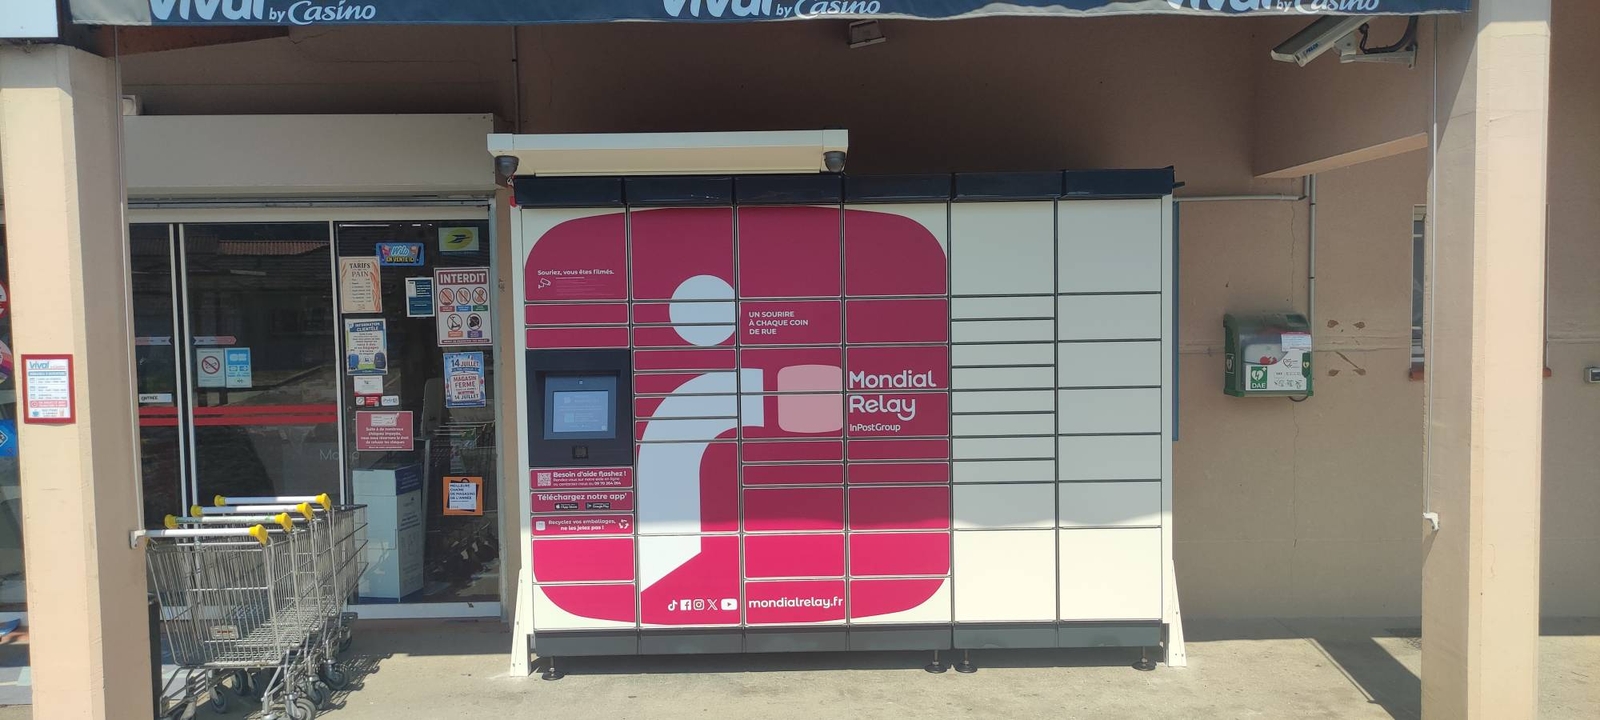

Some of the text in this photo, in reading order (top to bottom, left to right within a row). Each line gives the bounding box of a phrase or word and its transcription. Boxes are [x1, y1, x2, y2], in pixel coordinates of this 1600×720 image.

[269, 8, 286, 22] by
[288, 0, 376, 25] Casino
[776, 4, 792, 18] by
[794, 0, 880, 19] Casino
[1276, 0, 1290, 12] by
[440, 273, 485, 284] INTERDIT
[452, 359, 460, 367] 14
[850, 370, 936, 388] Mondial
[850, 395, 916, 421] Relay
[748, 596, 843, 609] mondialrelay.fr
